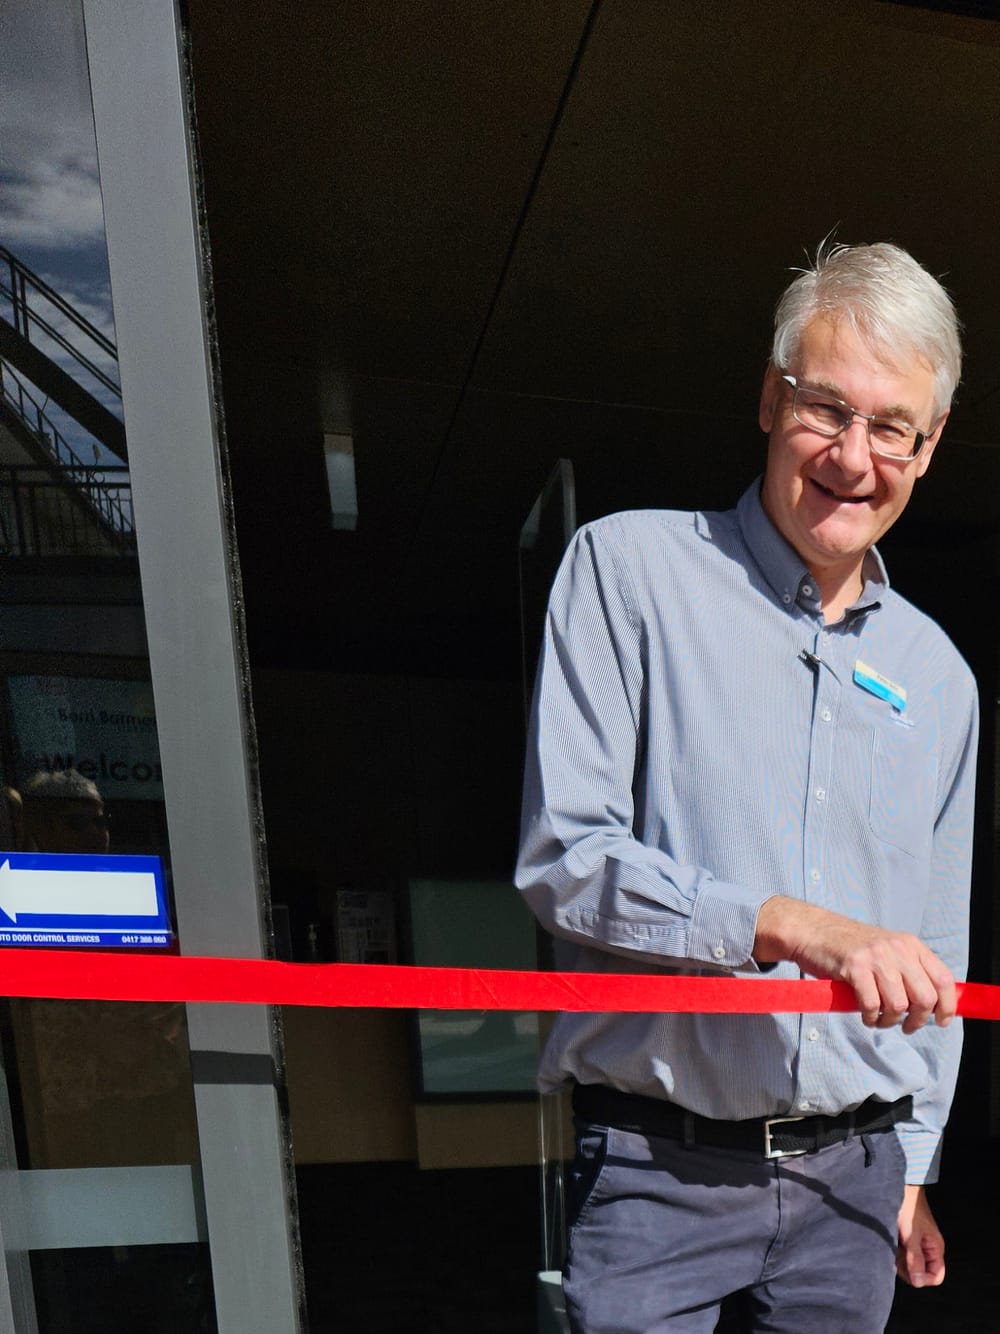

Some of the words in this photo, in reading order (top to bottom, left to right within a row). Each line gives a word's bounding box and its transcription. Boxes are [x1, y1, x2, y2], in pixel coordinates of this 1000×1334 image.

[38, 752, 161, 782] Welco
[12, 934, 32, 942] DOOR
[33, 935, 66, 943] CONTROL
[66, 935, 100, 943] SERVICES
